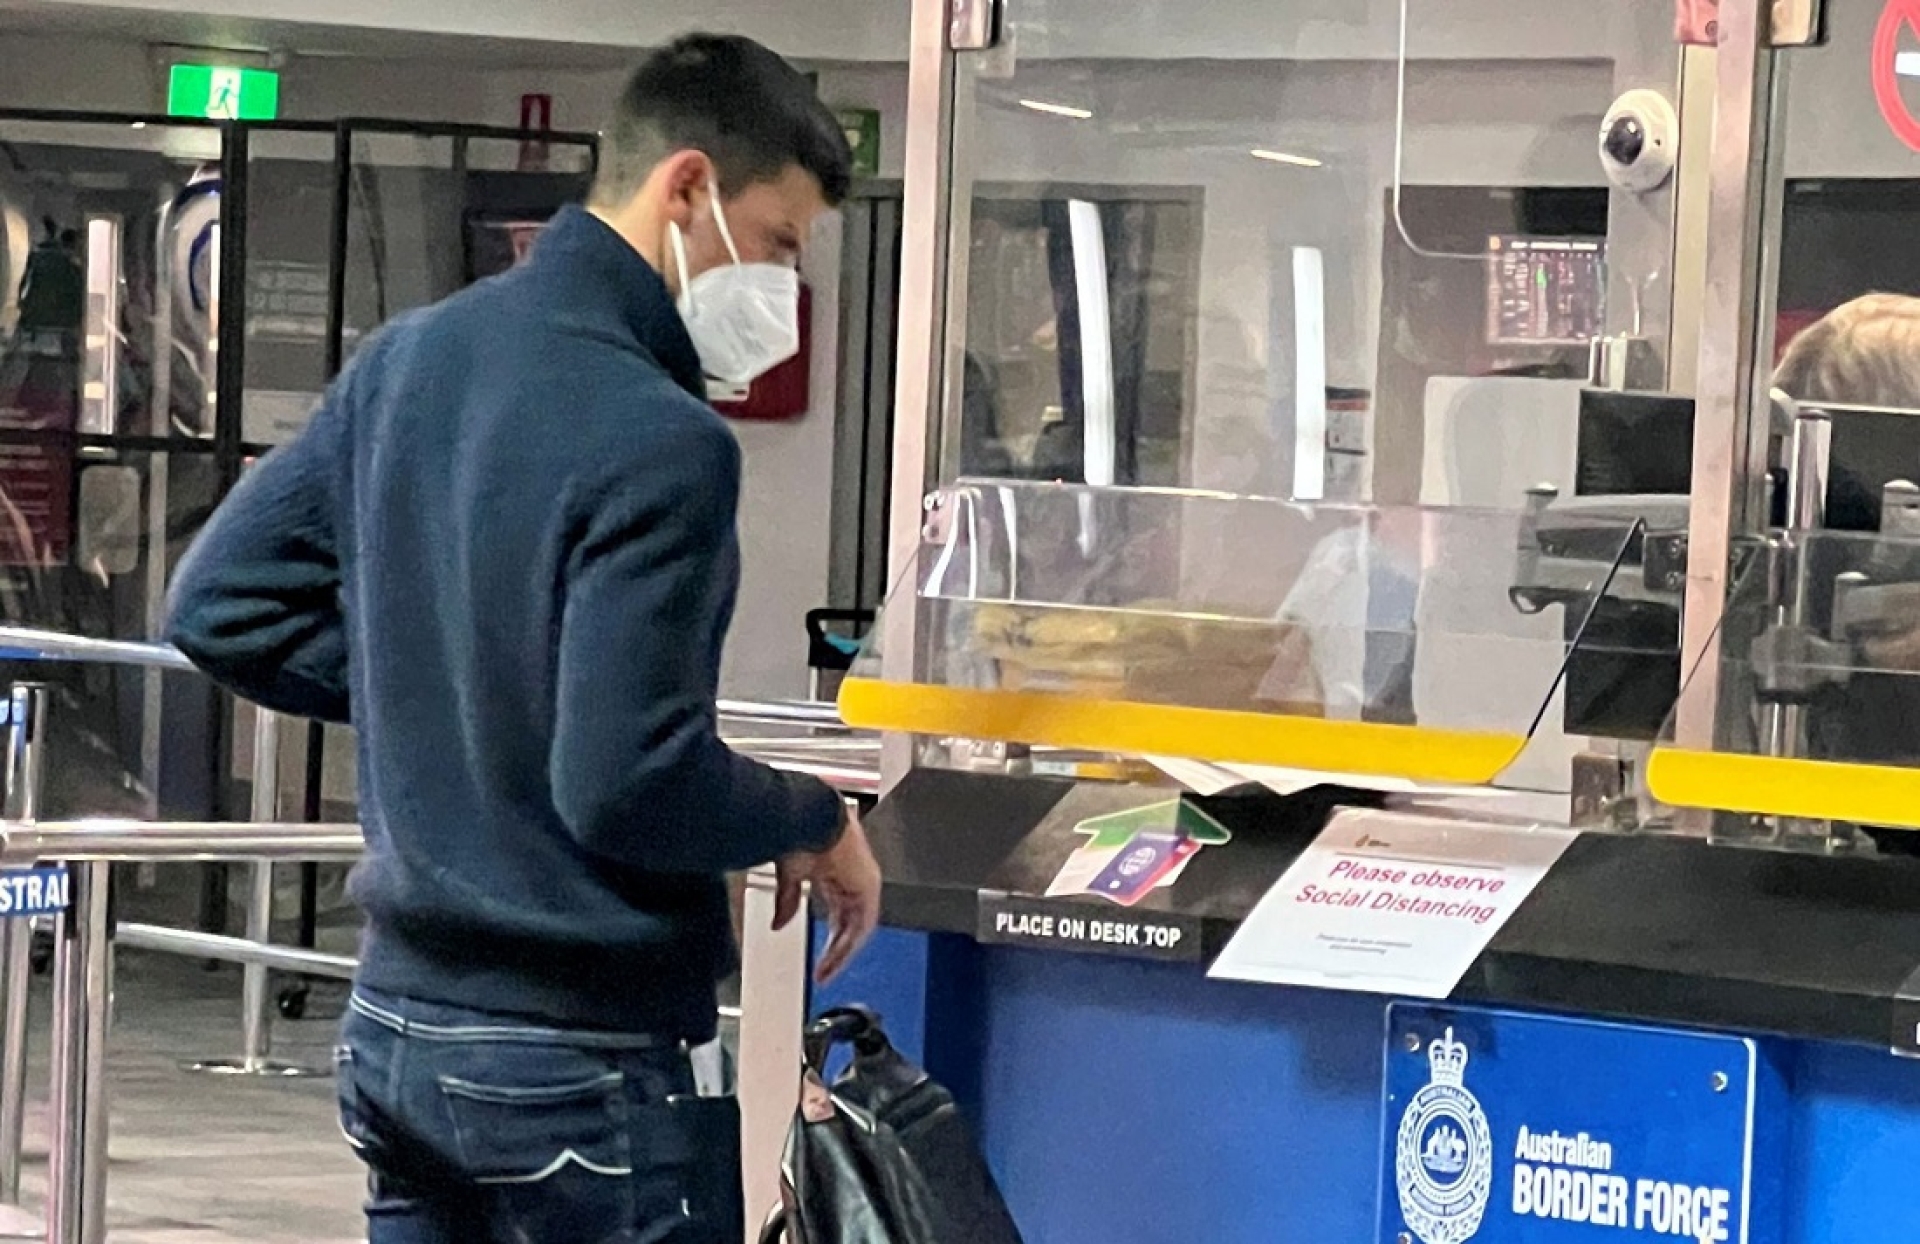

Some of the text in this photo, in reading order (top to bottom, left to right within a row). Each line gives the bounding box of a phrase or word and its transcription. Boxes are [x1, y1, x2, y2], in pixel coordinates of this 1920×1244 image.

[1328, 859, 1506, 893] Please observe
[1295, 883, 1497, 924] Social Distancing
[996, 912, 1181, 948] PLACE ON DESK TOP
[1514, 1124, 1612, 1170] Australian
[1512, 1163, 1629, 1228] BORDER
[1634, 1178, 1730, 1241] FORCE
